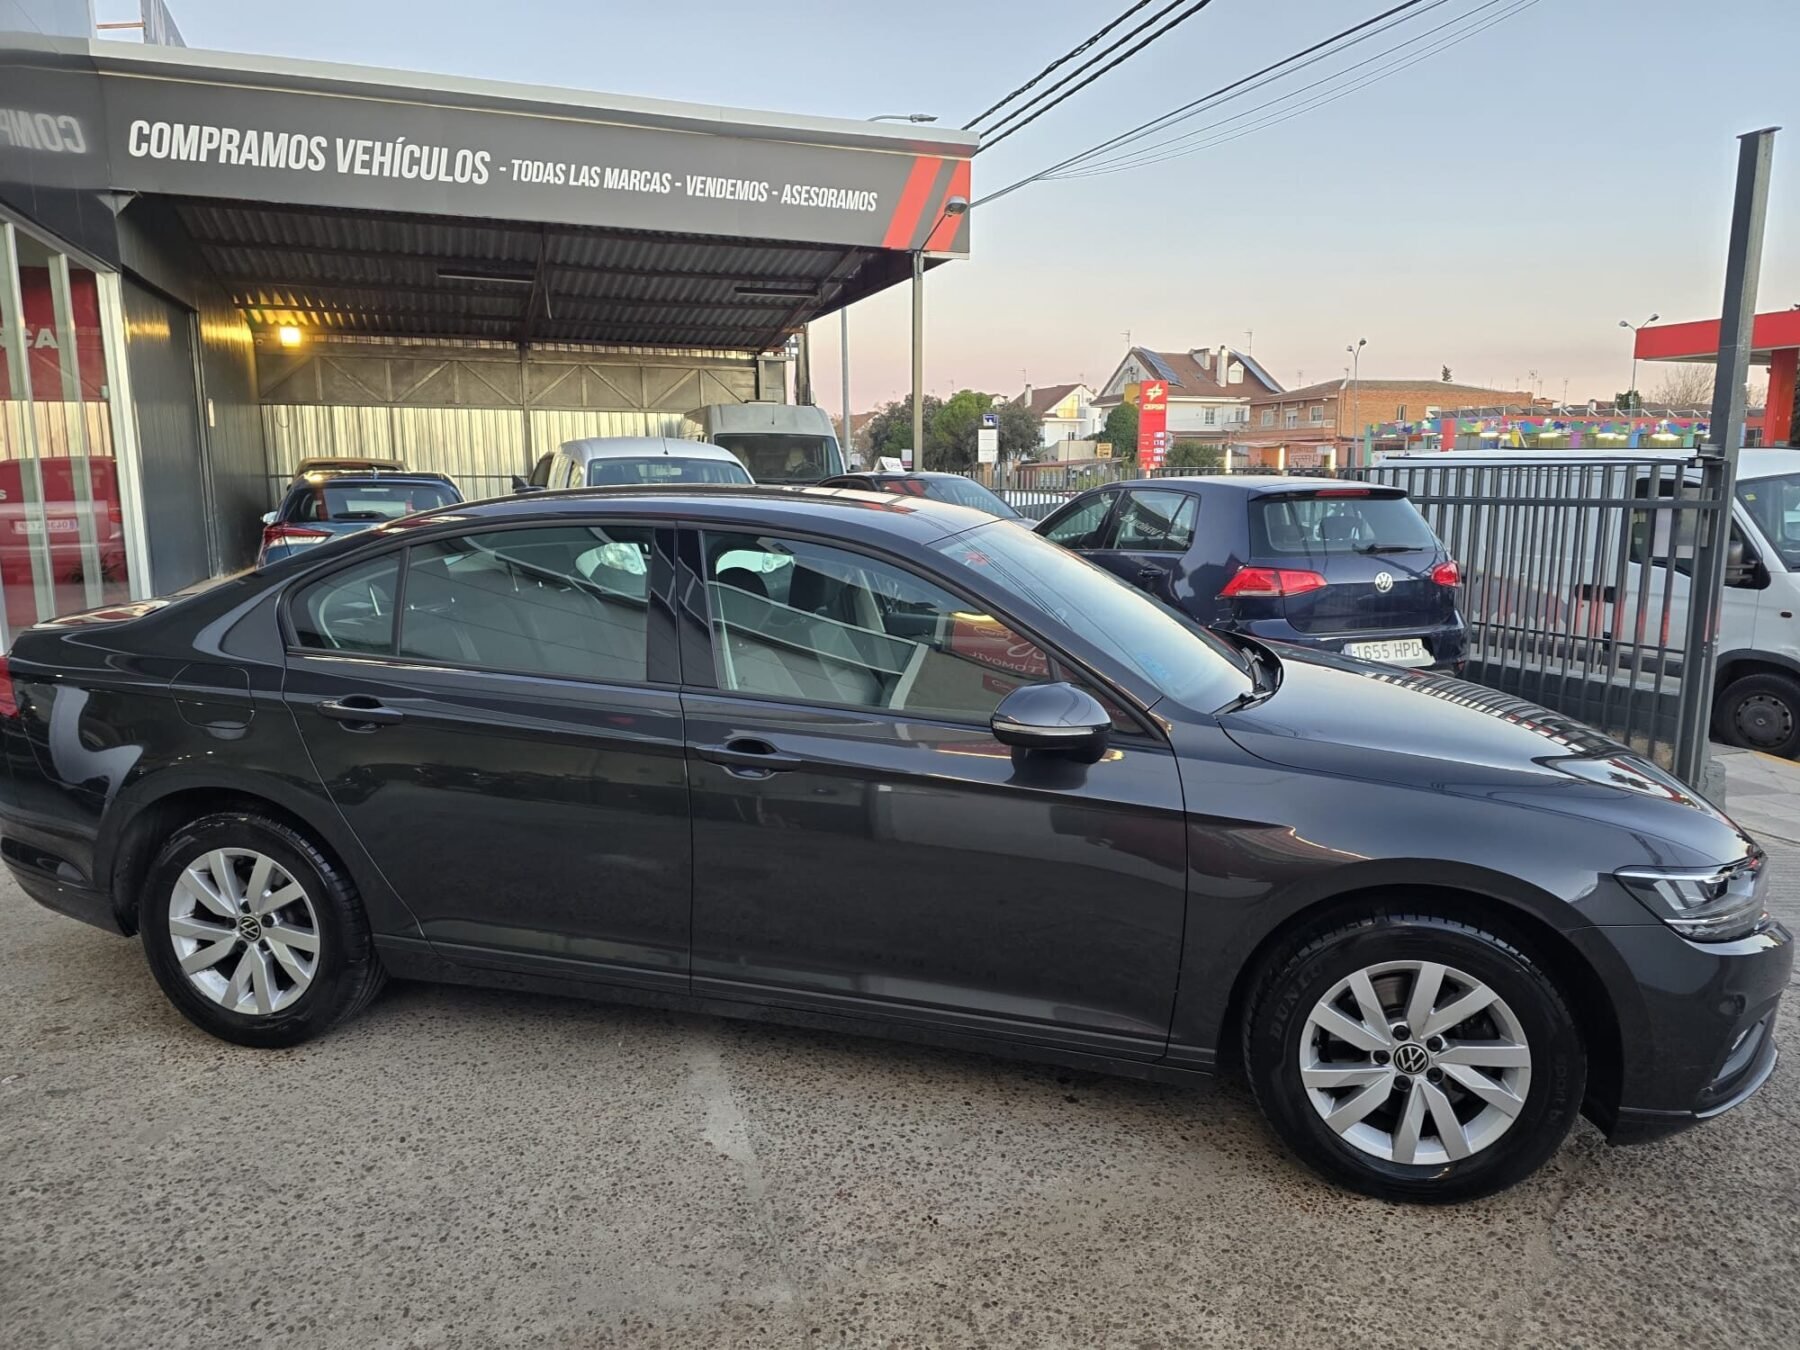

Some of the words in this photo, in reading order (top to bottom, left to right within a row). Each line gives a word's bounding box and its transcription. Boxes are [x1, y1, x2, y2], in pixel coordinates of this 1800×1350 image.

[128, 120, 328, 172] COMPRAMOS
[335, 136, 491, 185] VEHÍCULOS
[511, 159, 567, 186] TODAS
[568, 163, 601, 188] LAS
[604, 167, 672, 194] MARCAS
[686, 174, 770, 203] VENDEMOS
[781, 183, 878, 213] ASESORAMOS
[1356, 643, 1390, 660] 1655
[1394, 641, 1420, 658] HPD
